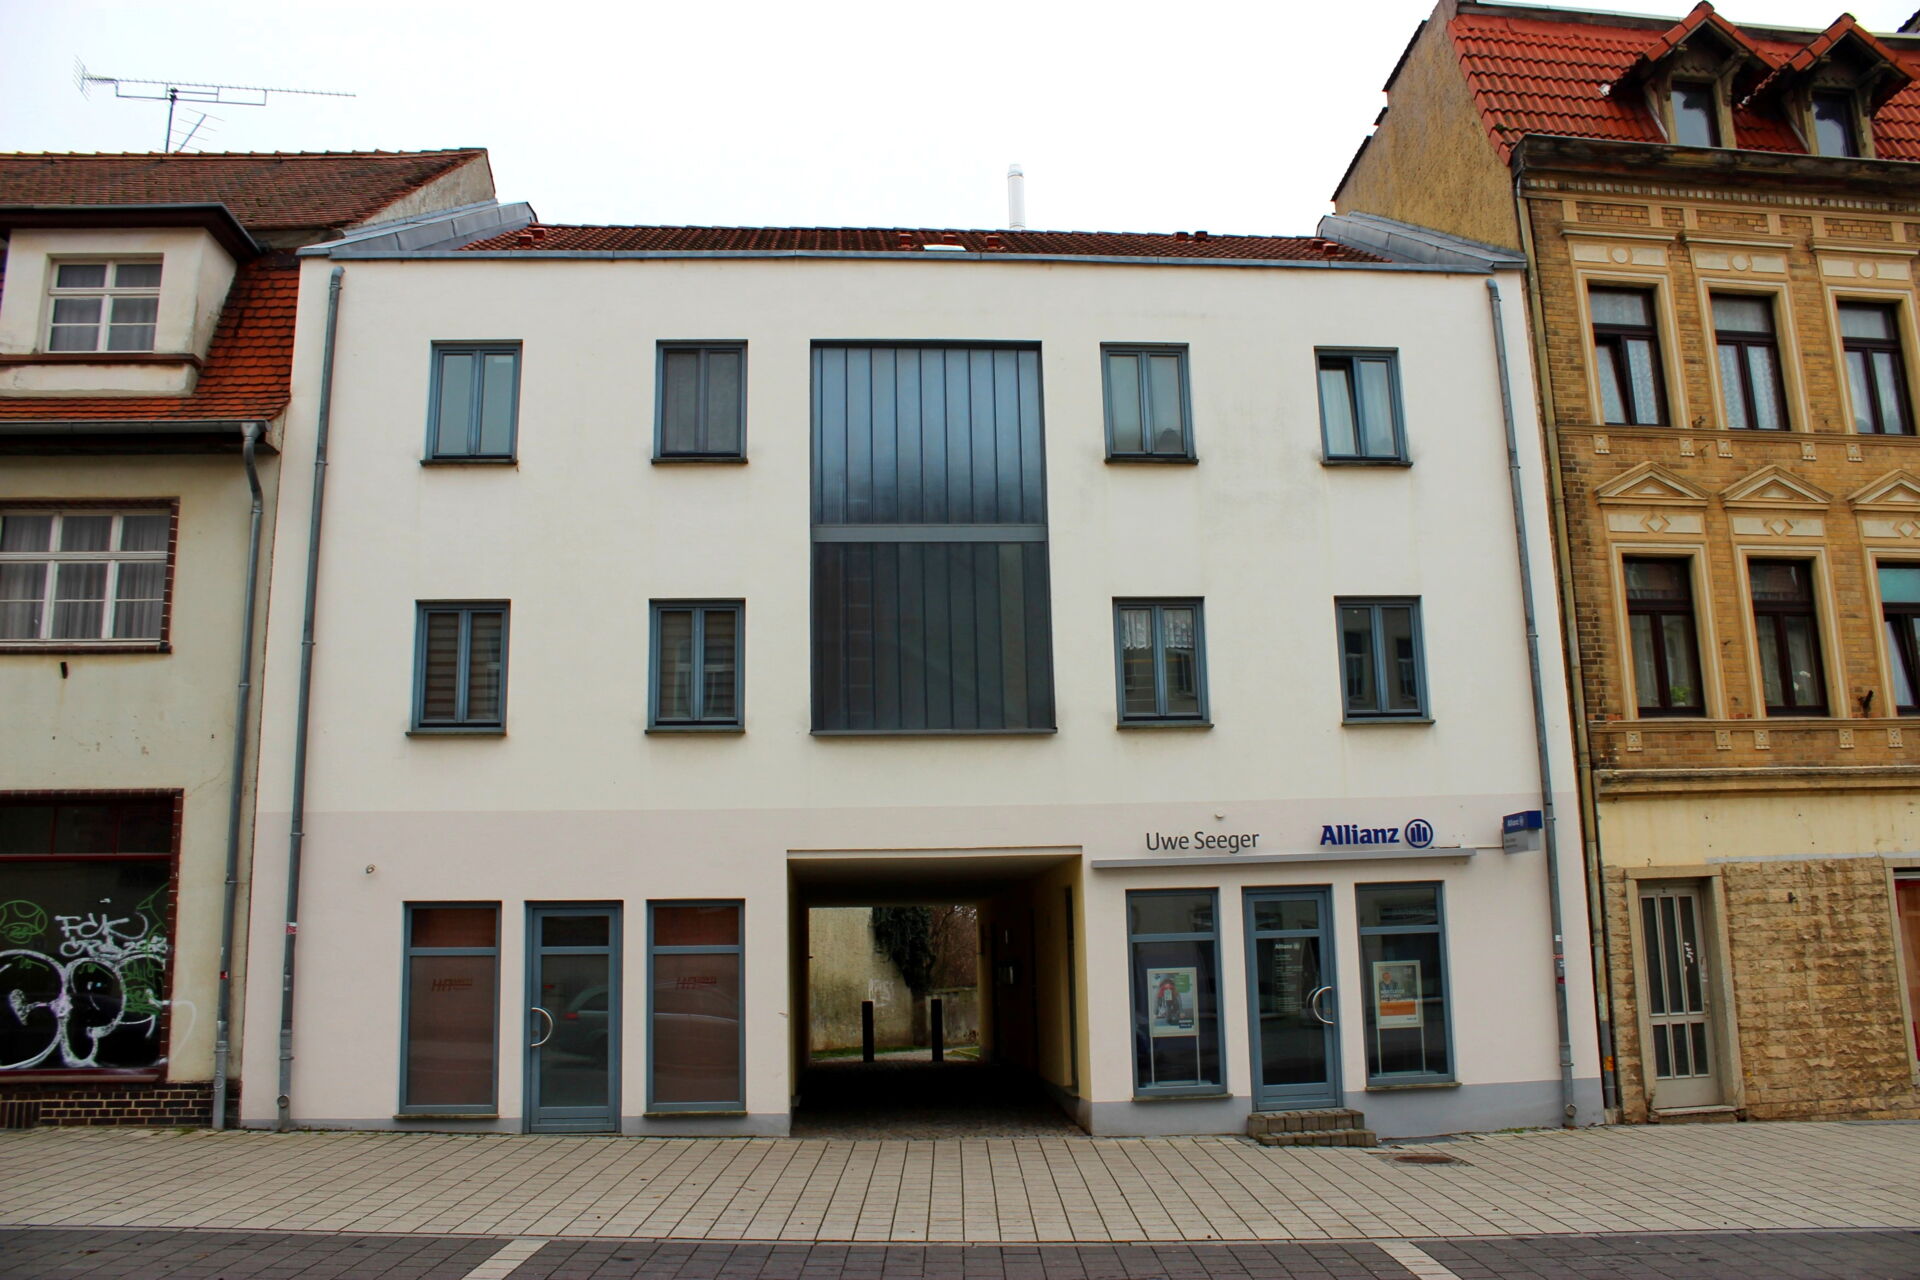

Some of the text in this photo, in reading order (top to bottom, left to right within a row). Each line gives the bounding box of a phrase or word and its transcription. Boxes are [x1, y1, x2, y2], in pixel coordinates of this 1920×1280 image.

[1146, 831, 1260, 854] Uwe Seeger
[1320, 824, 1400, 846] Allianz
